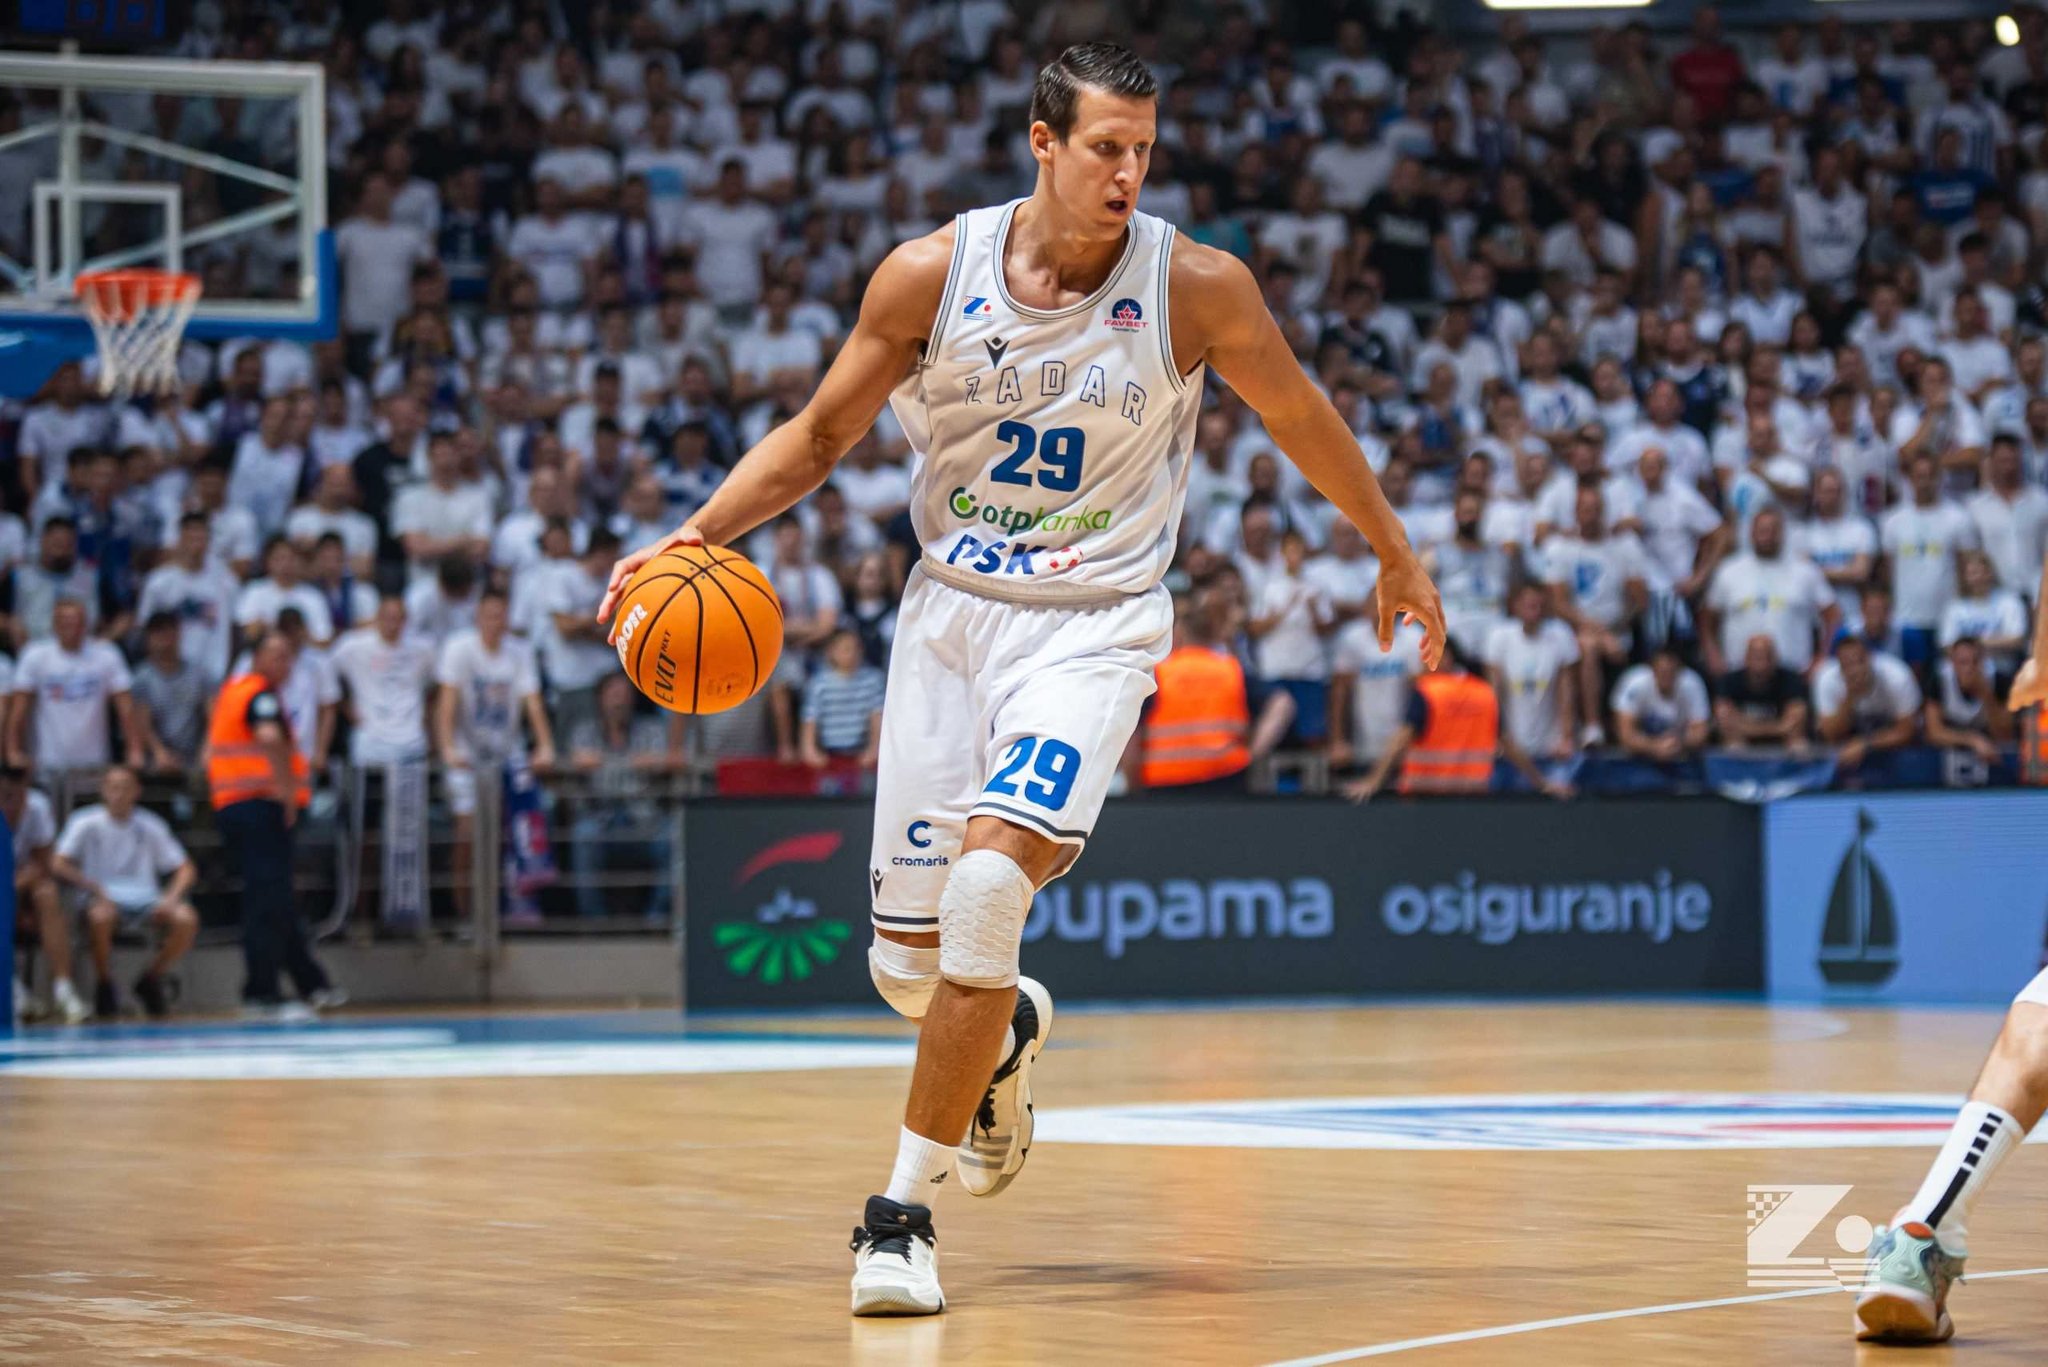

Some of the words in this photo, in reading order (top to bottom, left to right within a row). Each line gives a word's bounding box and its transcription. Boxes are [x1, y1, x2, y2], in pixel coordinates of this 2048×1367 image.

[1104, 319, 1149, 328] FAVBET
[965, 361, 1147, 426] ZADAR
[991, 420, 1086, 493] 29
[946, 534, 1050, 575] PSK
[983, 736, 1082, 812] 29
[892, 855, 949, 867] cromaris
[1382, 868, 1712, 944] osiguranje
